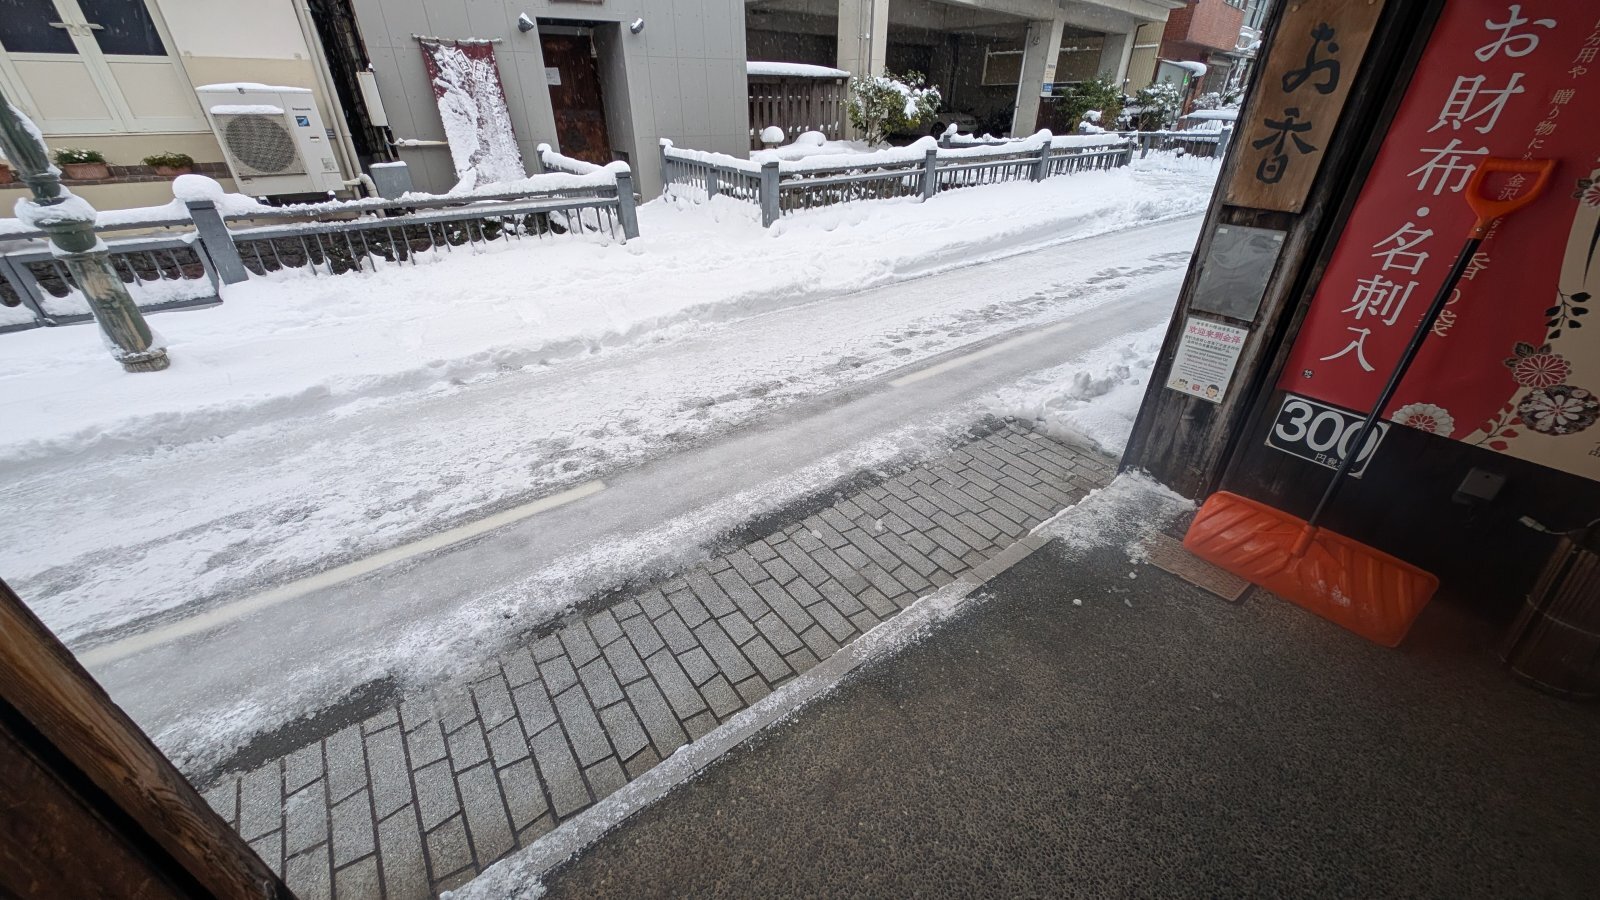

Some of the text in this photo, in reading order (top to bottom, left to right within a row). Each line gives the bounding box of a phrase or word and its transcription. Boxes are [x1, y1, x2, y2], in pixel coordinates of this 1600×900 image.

[1252, 22, 1341, 184] お香
[1320, 4, 1557, 372] お財布・名刺入
[1275, 401, 1379, 463] 300
